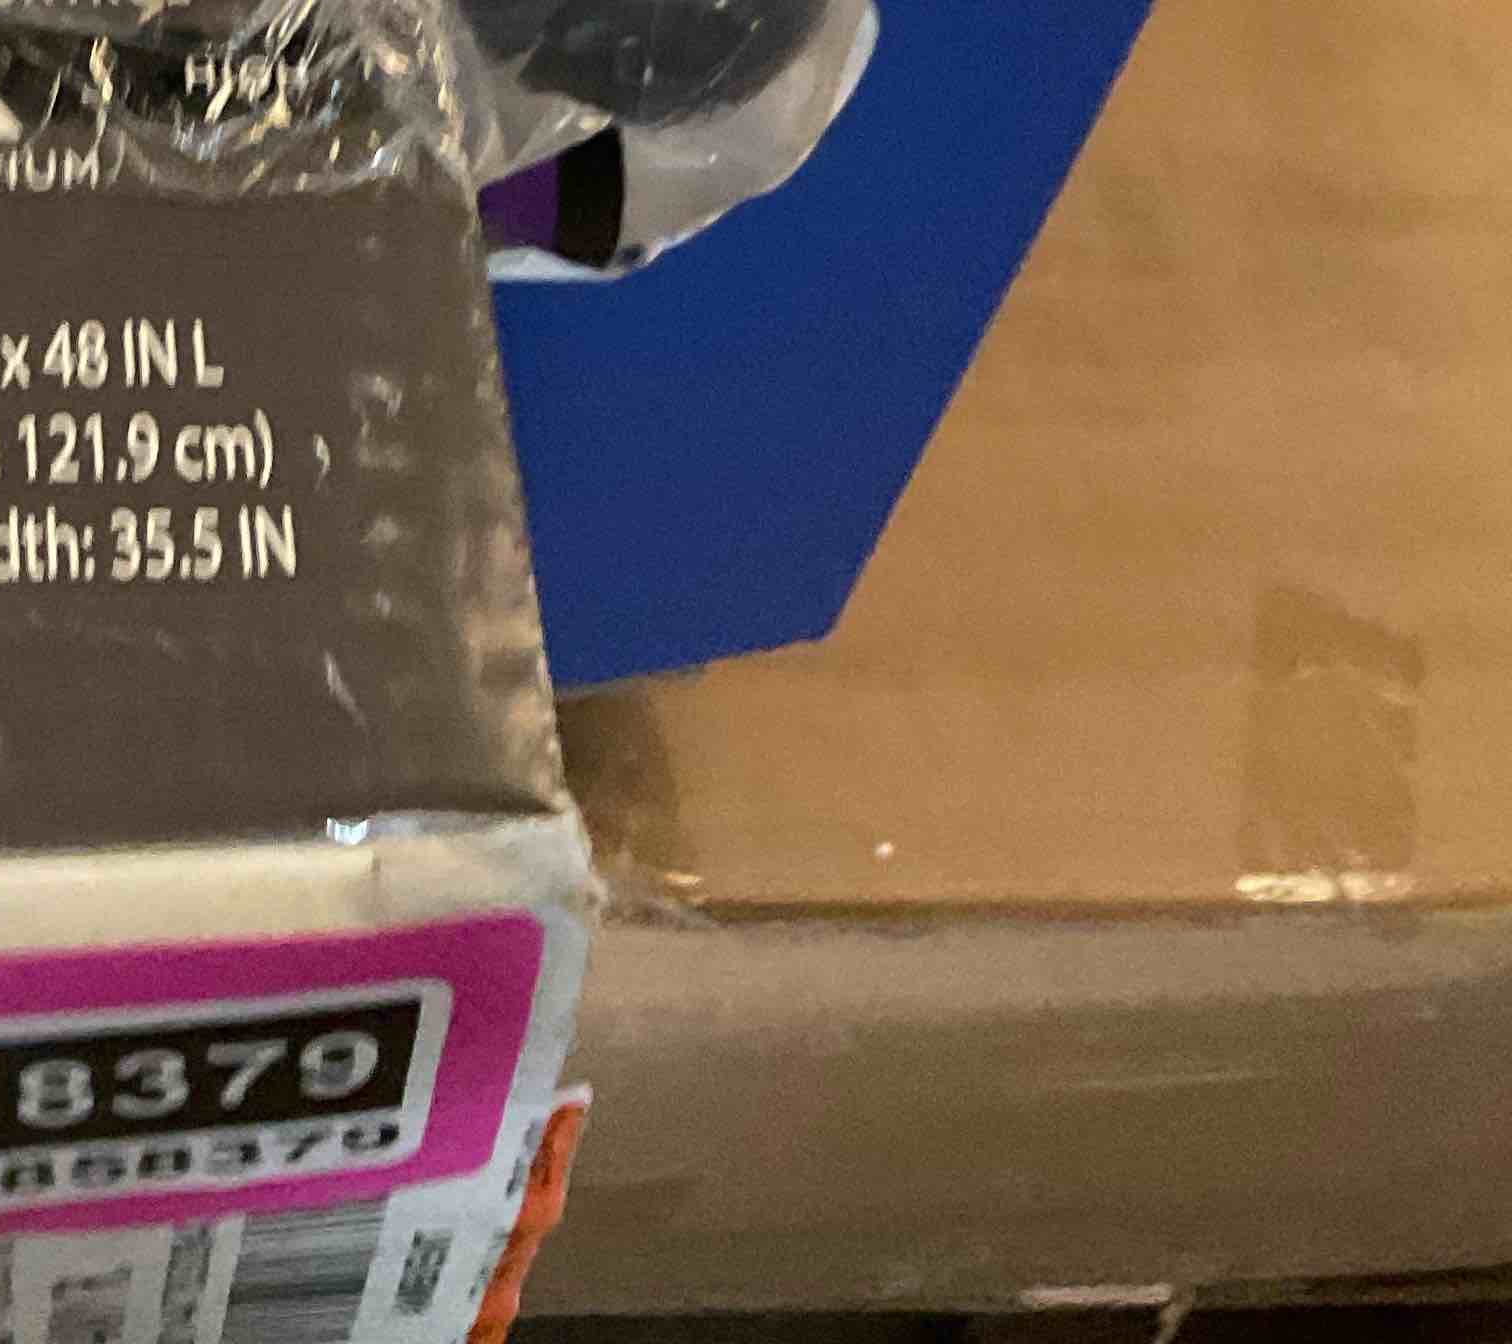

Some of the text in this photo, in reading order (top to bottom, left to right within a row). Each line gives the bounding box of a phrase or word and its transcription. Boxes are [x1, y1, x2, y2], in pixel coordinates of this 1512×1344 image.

[0, 333, 31, 391] x
[42, 318, 109, 389] 48
[121, 316, 179, 388] IN
[193, 317, 225, 387] L
[17, 410, 161, 485] 121.9
[173, 408, 275, 489] cm)
[110, 505, 223, 583] 35.5
[237, 503, 297, 581] IN
[15, 1028, 382, 1131] 8379
